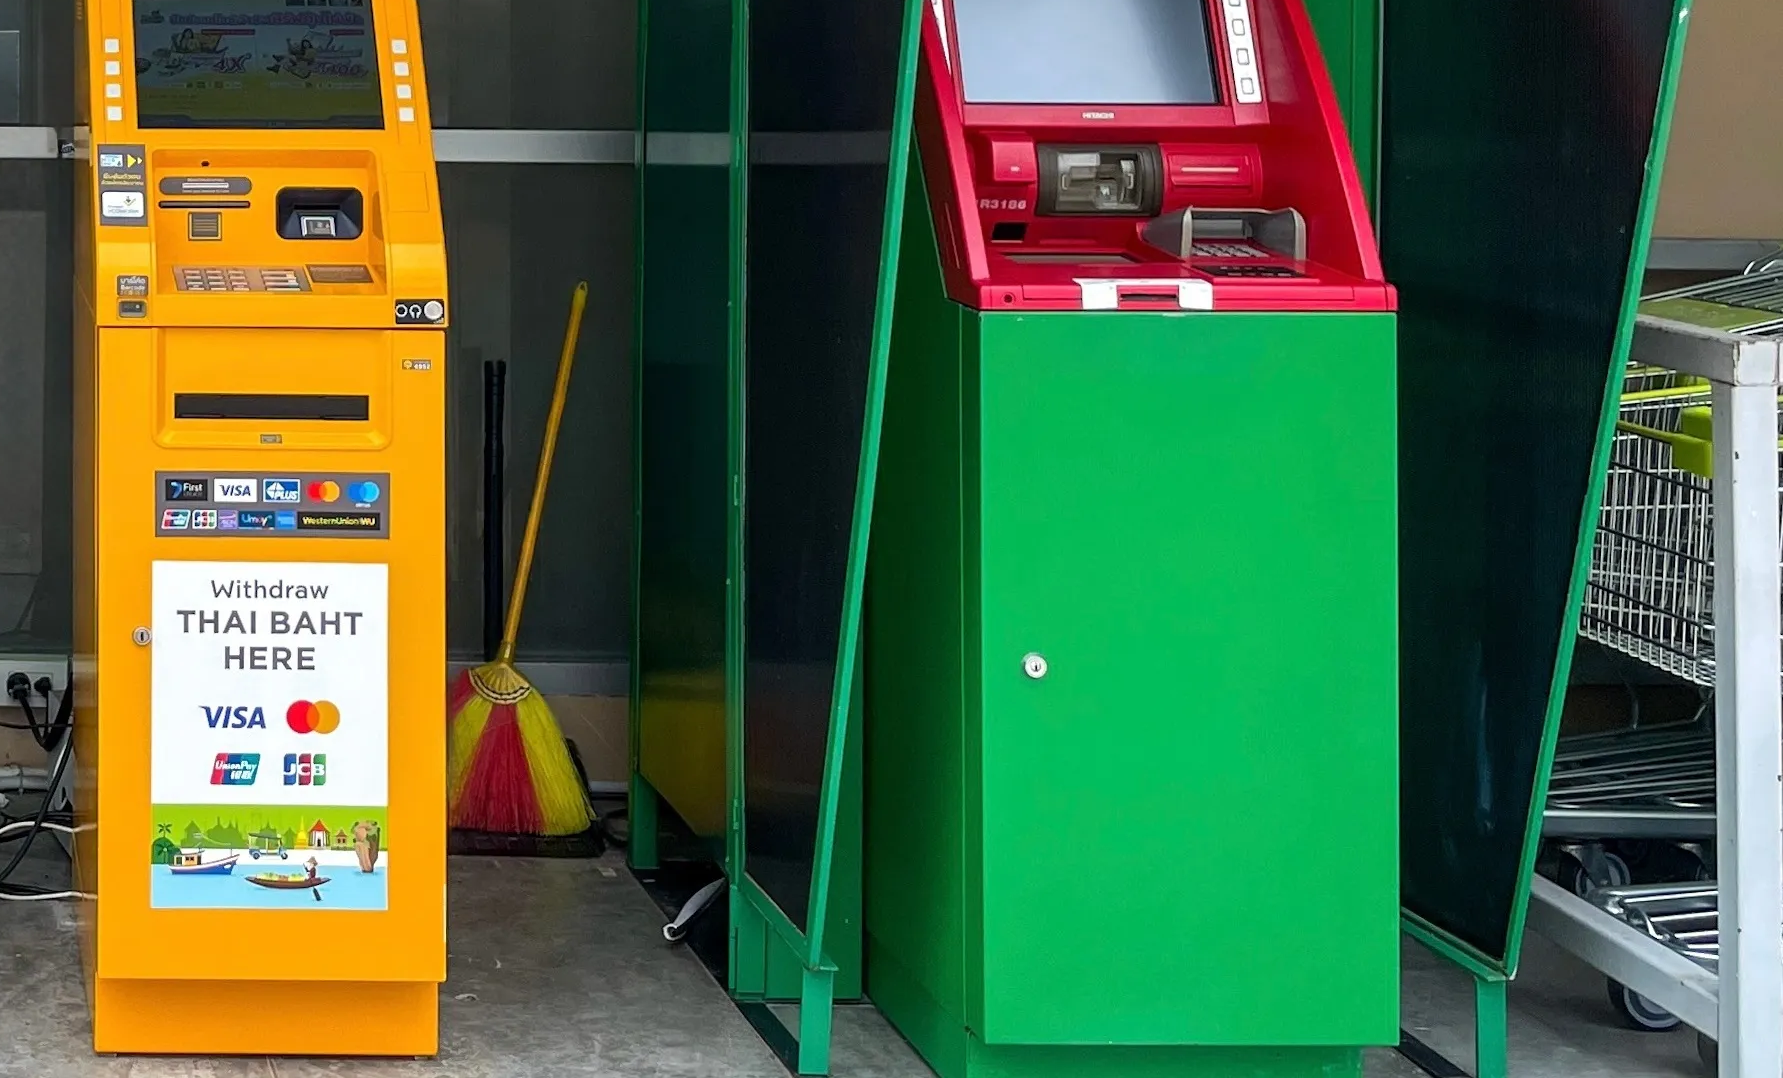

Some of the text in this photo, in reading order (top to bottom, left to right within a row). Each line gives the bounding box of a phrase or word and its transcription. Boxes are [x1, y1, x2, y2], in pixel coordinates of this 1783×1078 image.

[183, 481, 203, 492] First
[219, 484, 298, 500] VISA PLUS
[210, 579, 329, 600] Withdraw
[176, 609, 364, 636] THAI BAHT
[224, 646, 316, 671] HERE
[198, 705, 267, 729] VISA
[283, 763, 326, 777] JCB
